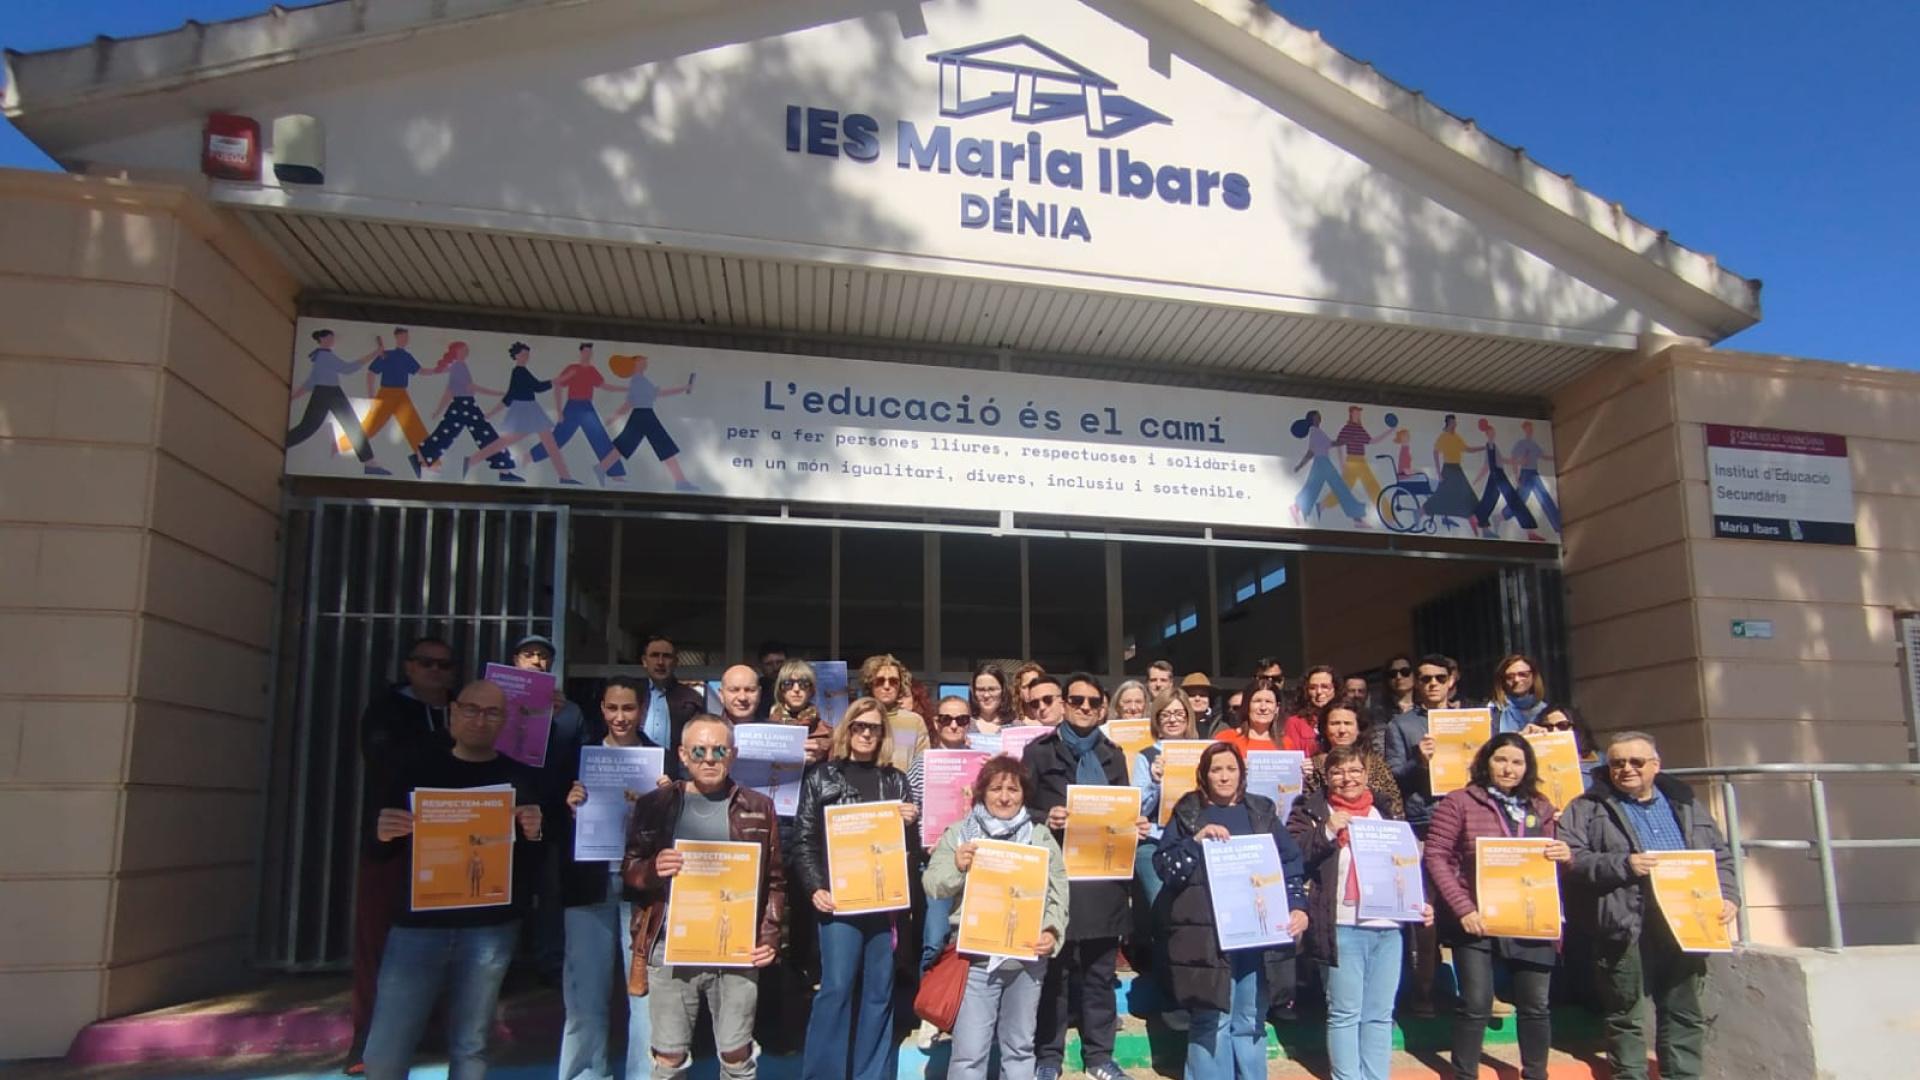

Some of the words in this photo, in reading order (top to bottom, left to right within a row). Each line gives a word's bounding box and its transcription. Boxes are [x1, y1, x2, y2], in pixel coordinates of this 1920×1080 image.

[785, 104, 881, 163] IES
[896, 120, 1084, 191] Maria
[1099, 147, 1252, 211] Ibars
[960, 188, 1092, 243] DÉNIA
[1018, 401, 1062, 432] és
[1080, 407, 1123, 436] el
[1139, 415, 1226, 444] camí
[727, 425, 759, 440] per
[771, 429, 782, 441] a
[793, 428, 824, 443] fer
[835, 432, 920, 450] persones
[930, 437, 1010, 458] lliures,
[1021, 445, 1137, 465] respectuoses
[1147, 453, 1156, 466] i
[1166, 455, 1257, 474] solidàries
[1714, 463, 1760, 481] Institut
[732, 455, 753, 469] en
[765, 458, 787, 470] un
[797, 458, 830, 473] món
[841, 462, 955, 483] igualitari,
[966, 468, 1035, 488] divers,
[1047, 474, 1124, 492] inclusiu
[1134, 480, 1143, 493] i
[1153, 482, 1253, 501] sostenible.
[1719, 520, 1750, 534] Maria
[1753, 523, 1780, 536] Ibars
